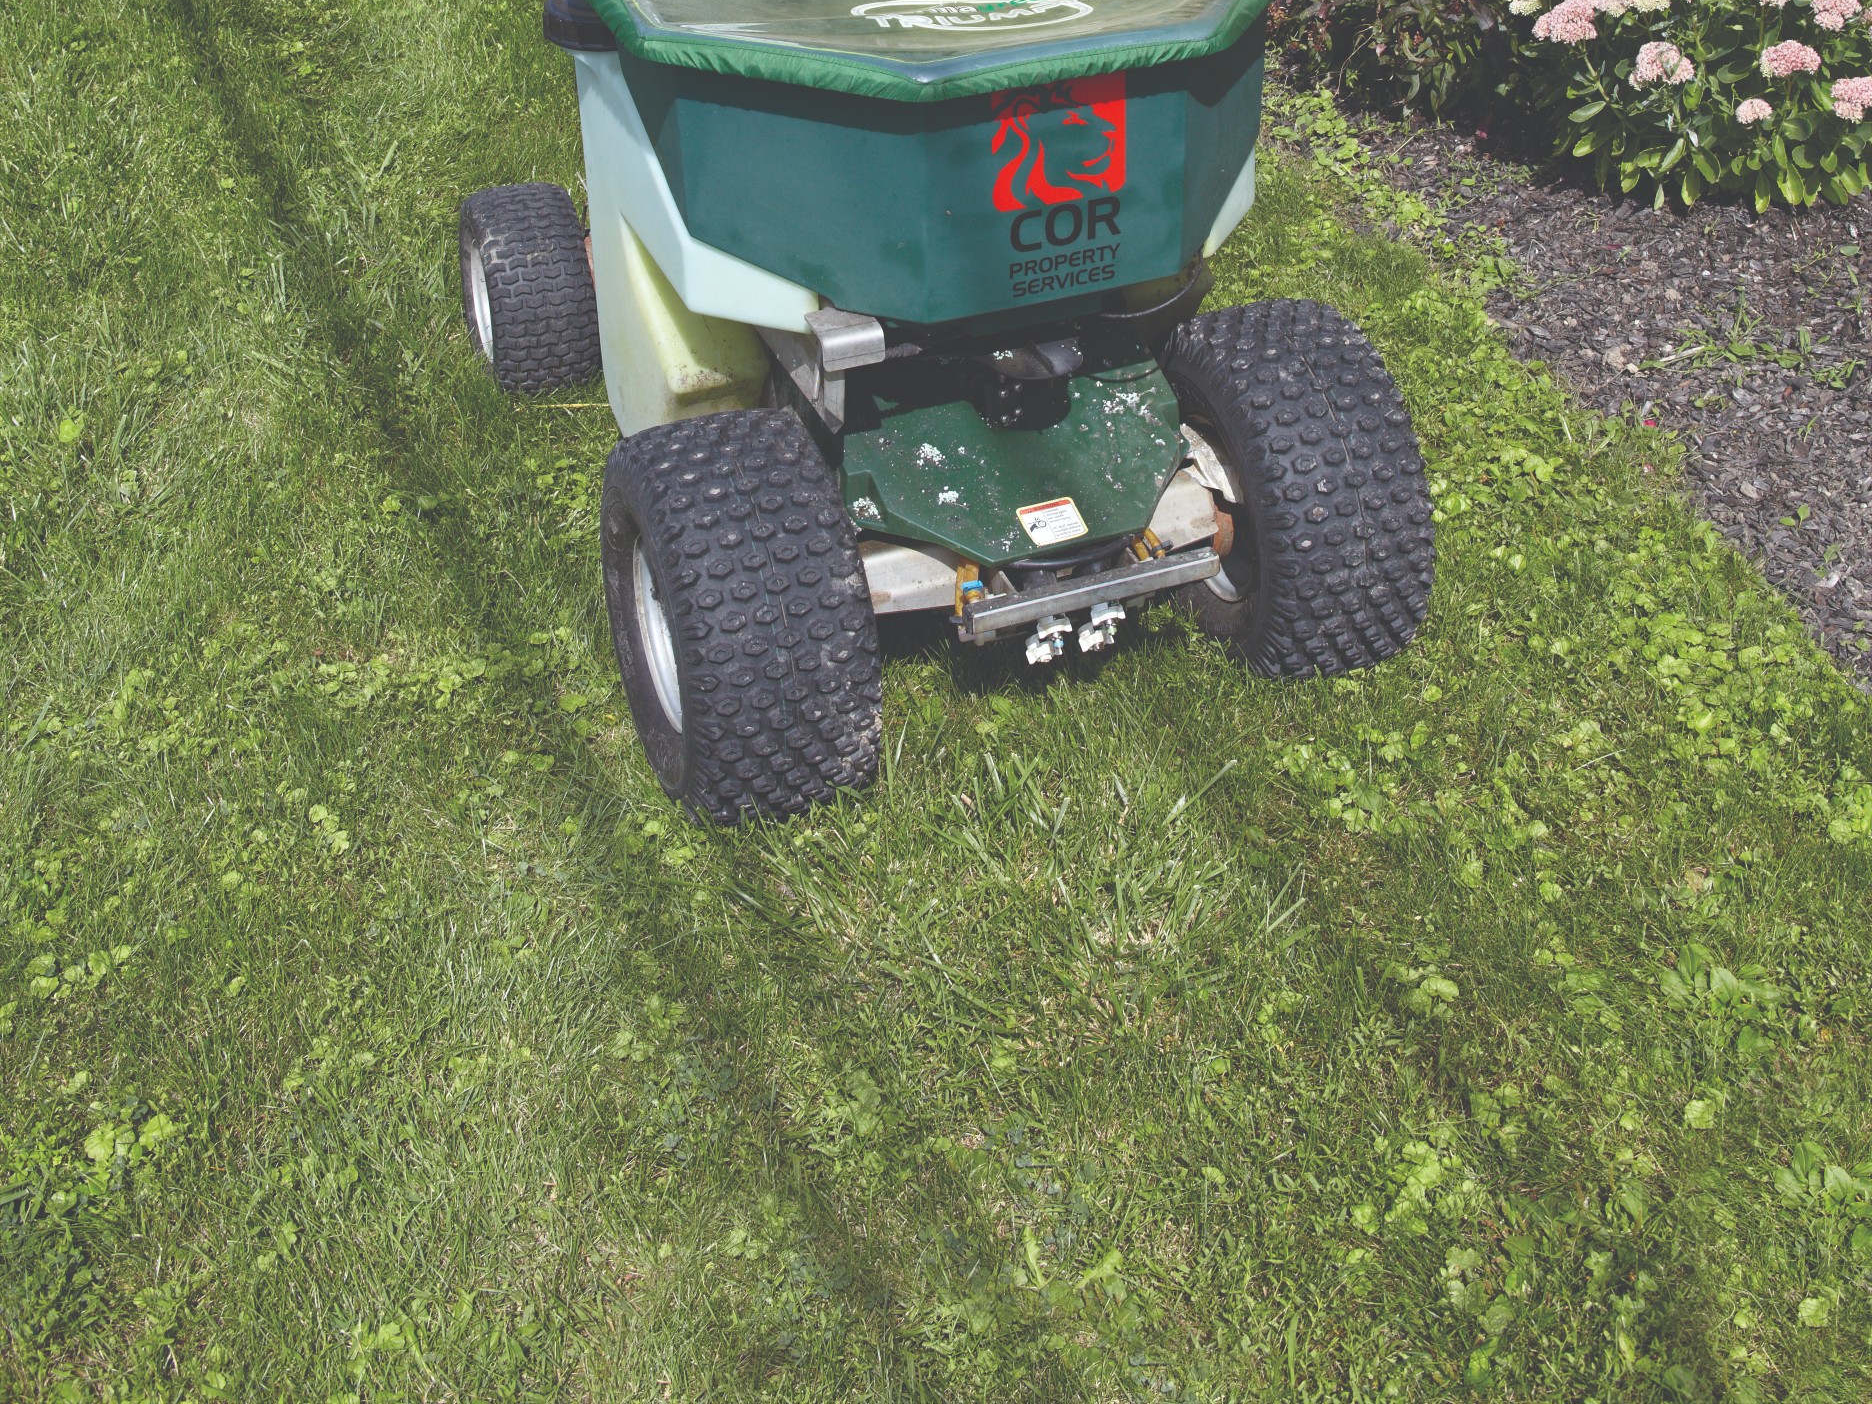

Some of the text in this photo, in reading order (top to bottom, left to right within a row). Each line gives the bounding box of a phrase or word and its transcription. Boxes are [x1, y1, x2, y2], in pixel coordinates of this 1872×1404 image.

[1009, 195, 1122, 253] COR
[1009, 242, 1122, 280] PROPERTY
[1012, 263, 1116, 298] SERVICES
